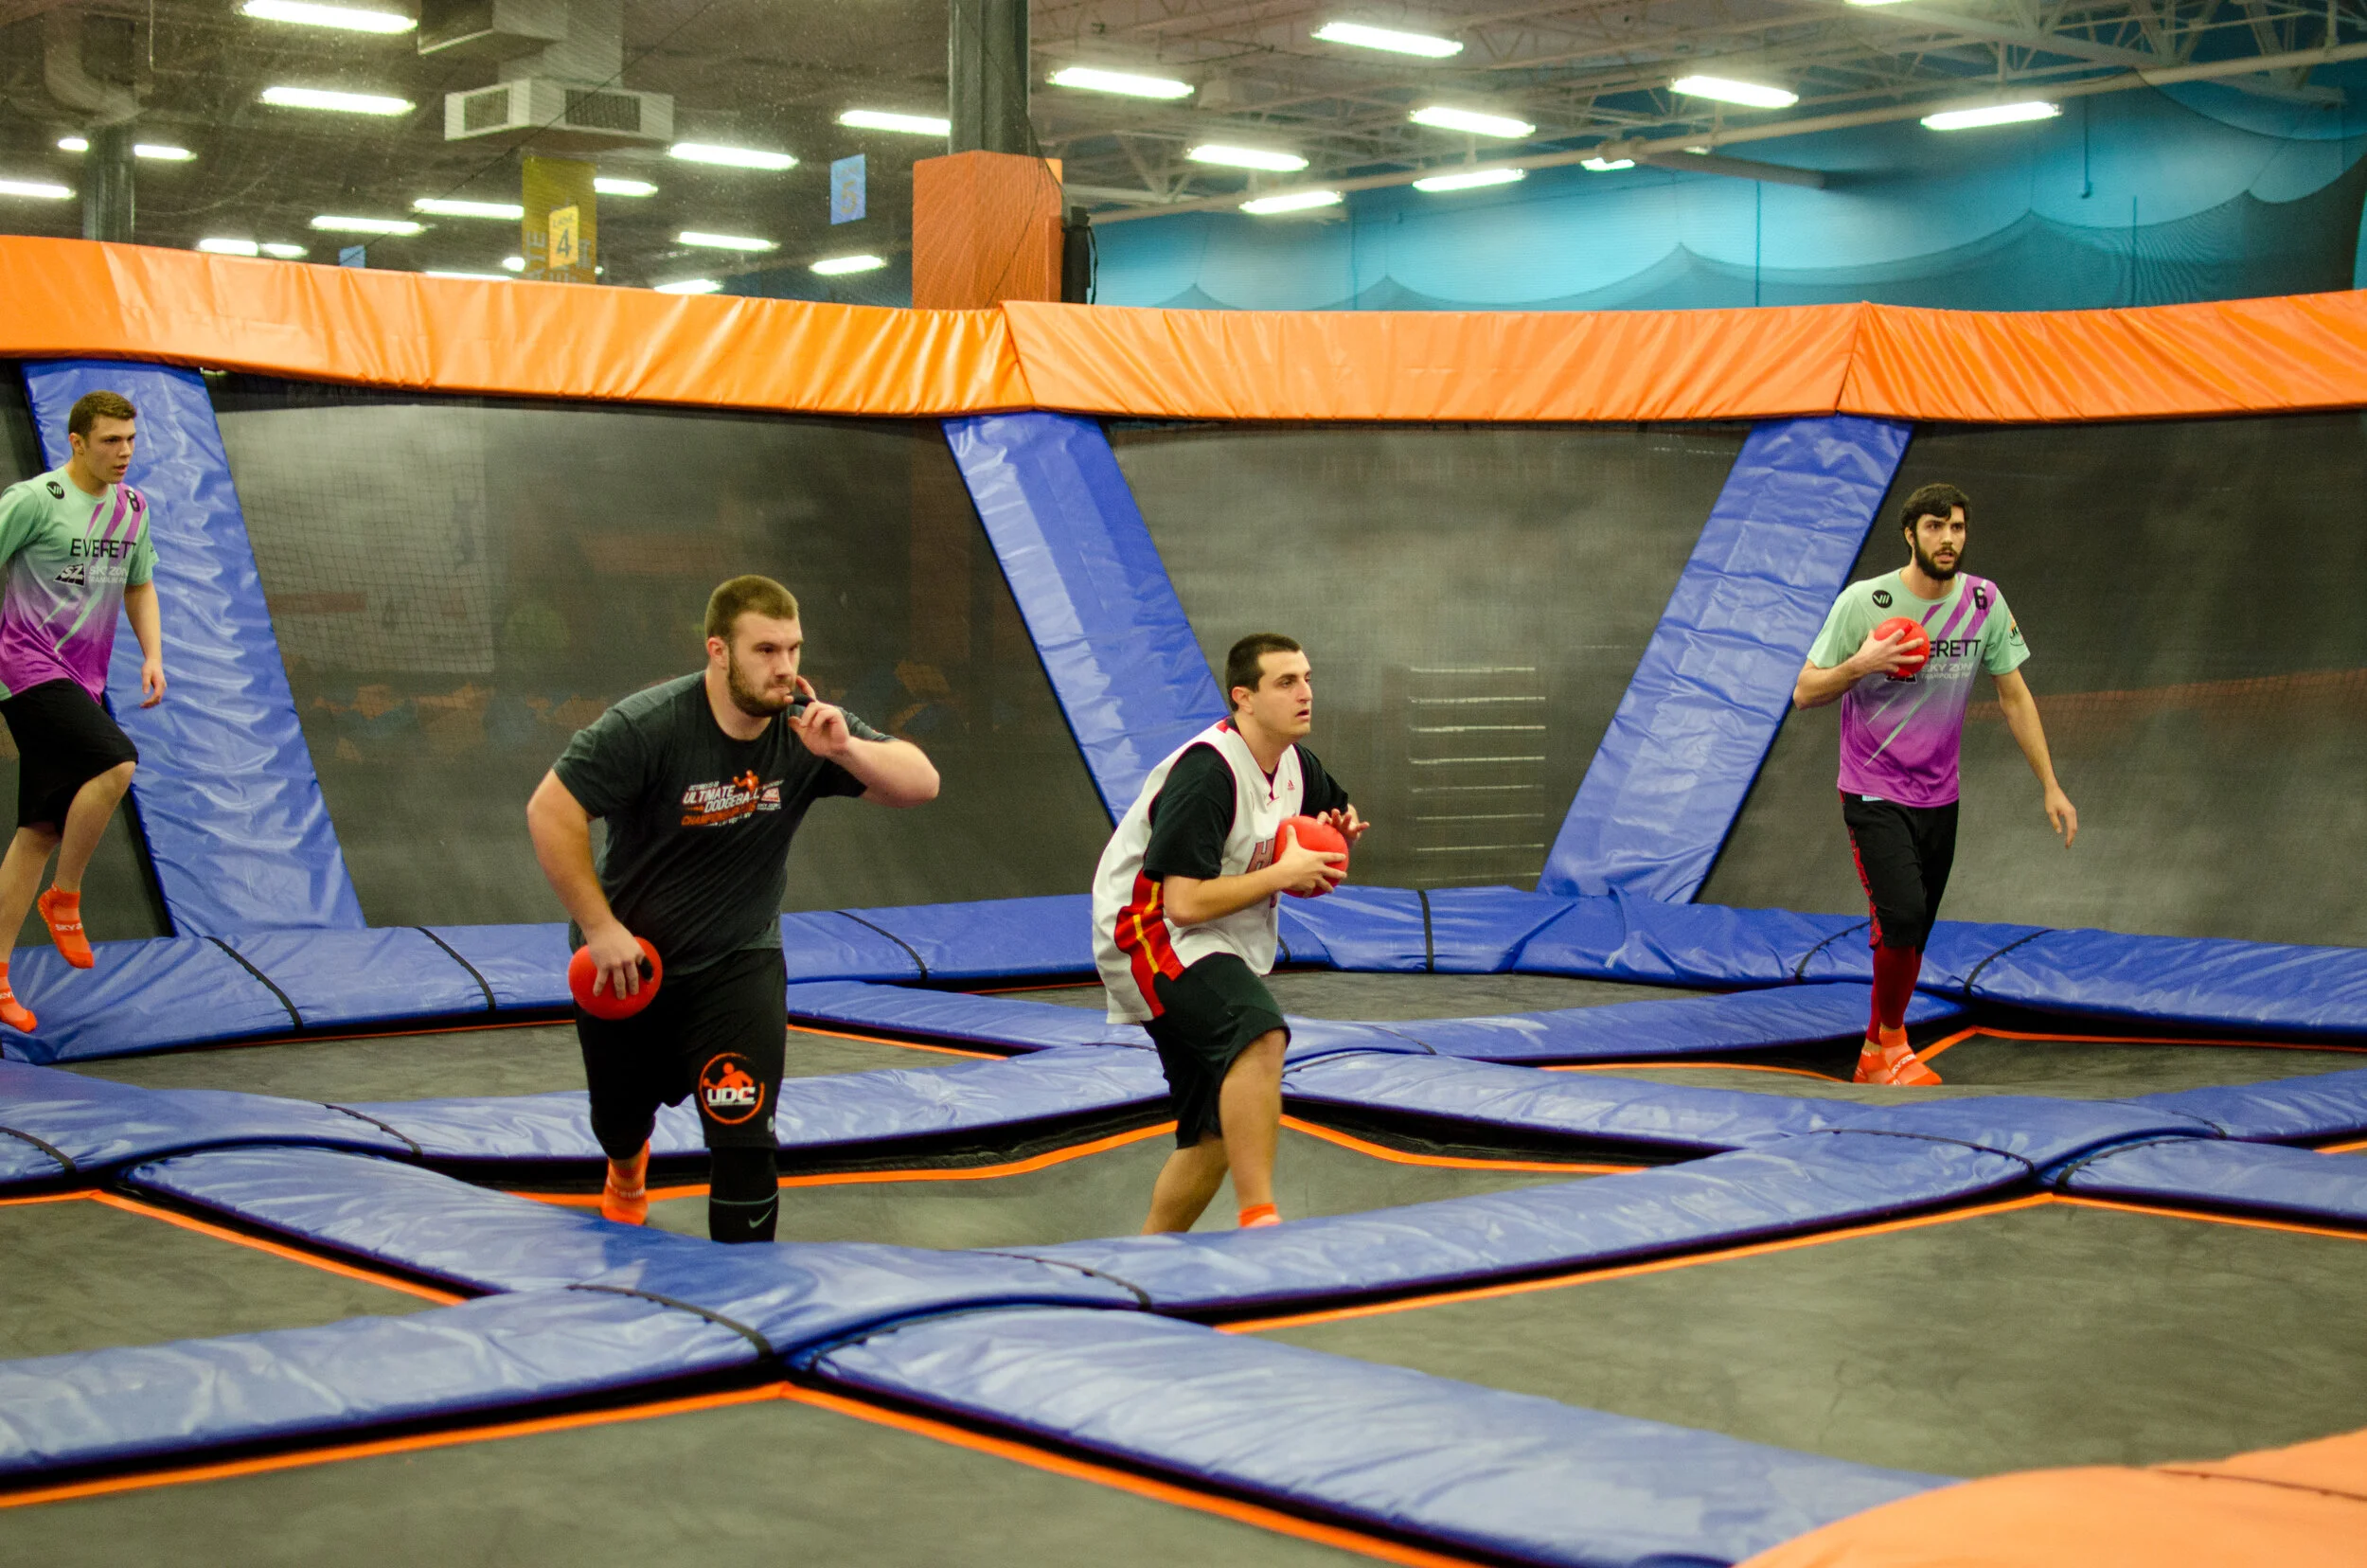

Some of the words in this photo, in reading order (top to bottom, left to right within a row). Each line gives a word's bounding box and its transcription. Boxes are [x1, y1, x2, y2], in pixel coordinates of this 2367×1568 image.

[841, 180, 857, 214] 5
[557, 228, 572, 258] 4
[1972, 586, 1988, 611] 6
[1929, 639, 1981, 658] ERETT
[707, 1086, 756, 1104] UDC
